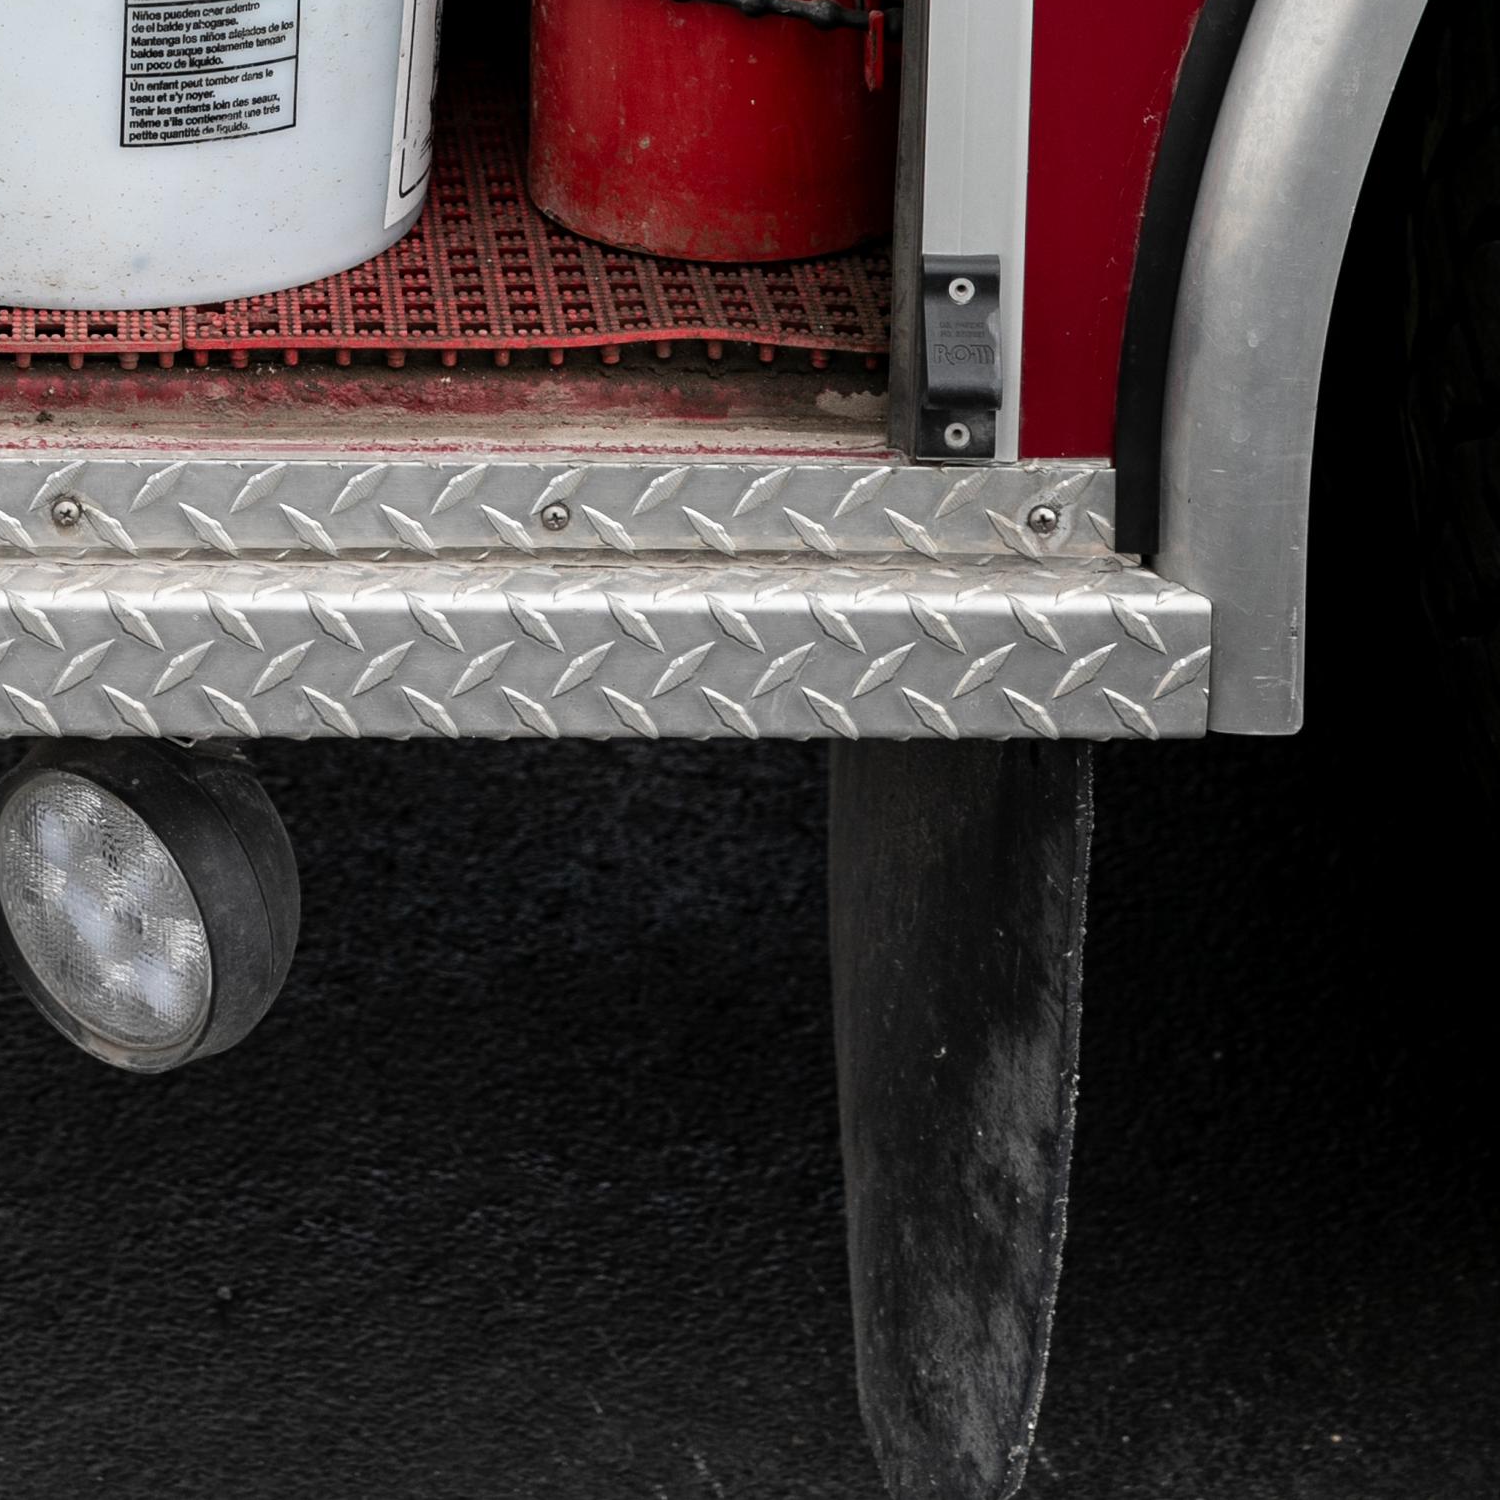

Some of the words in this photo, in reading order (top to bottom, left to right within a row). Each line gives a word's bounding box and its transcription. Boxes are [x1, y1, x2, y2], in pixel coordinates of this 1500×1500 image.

[132, 10, 161, 21] Niños
[225, 2, 260, 14] adentro
[132, 23, 144, 33] de
[146, 23, 155, 32] el
[157, 21, 184, 32] balde
[185, 23, 190, 32] y
[131, 62, 143, 70] un
[146, 61, 172, 73] poco
[174, 58, 186, 68] de
[146, 80, 179, 91] enfant
[181, 78, 203, 93] peut
[205, 75, 240, 87] tomber
[241, 70, 263, 82] dans
[265, 68, 273, 77] le
[130, 94, 155, 103] seau
[157, 92, 167, 102] et
[186, 89, 215, 103] noyer.
[130, 106, 155, 116] Tenir
[157, 105, 172, 115] les
[174, 102, 211, 114] enfants
[213, 100, 230, 111] loin
[233, 97, 249, 108] des
[252, 93, 280, 105] seaux,
[933, 343, 995, 366] ROM
